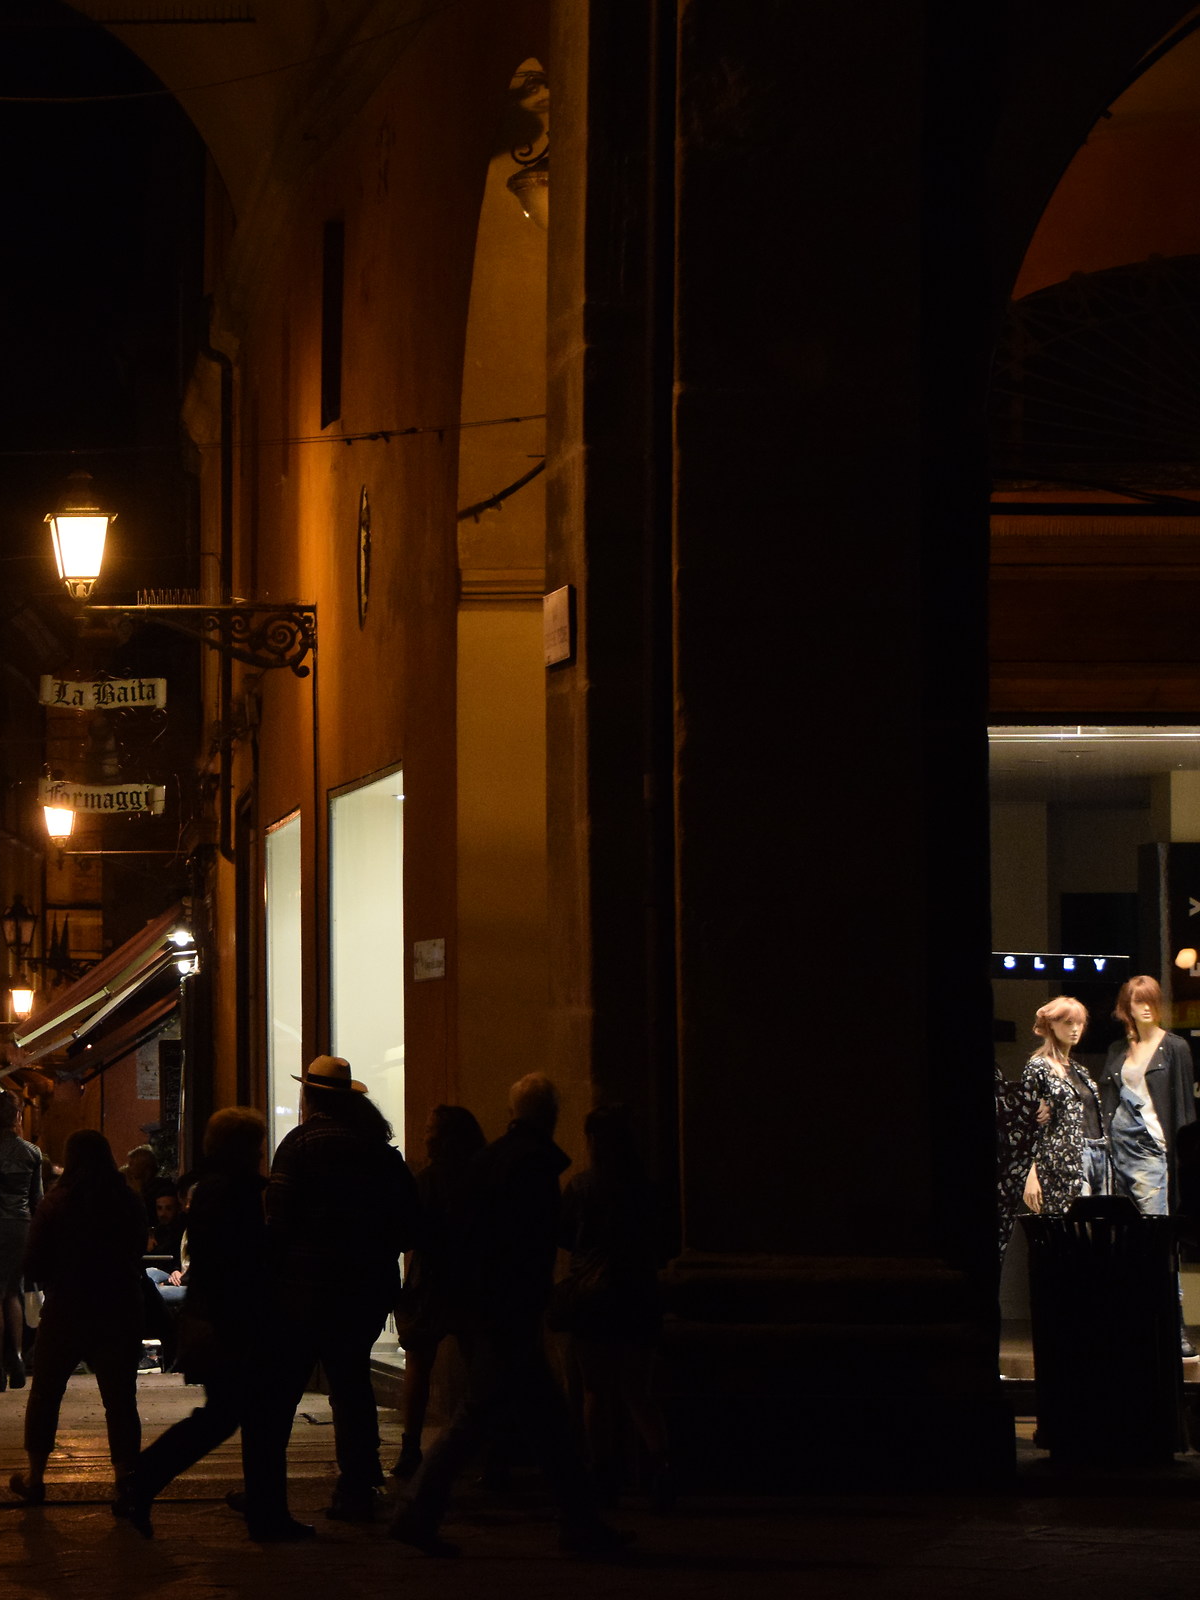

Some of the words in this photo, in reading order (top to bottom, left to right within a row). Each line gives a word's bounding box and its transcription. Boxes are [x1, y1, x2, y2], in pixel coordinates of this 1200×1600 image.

[53, 682, 84, 706] La
[92, 680, 156, 705] Baita
[45, 783, 152, 810] Formaggi
